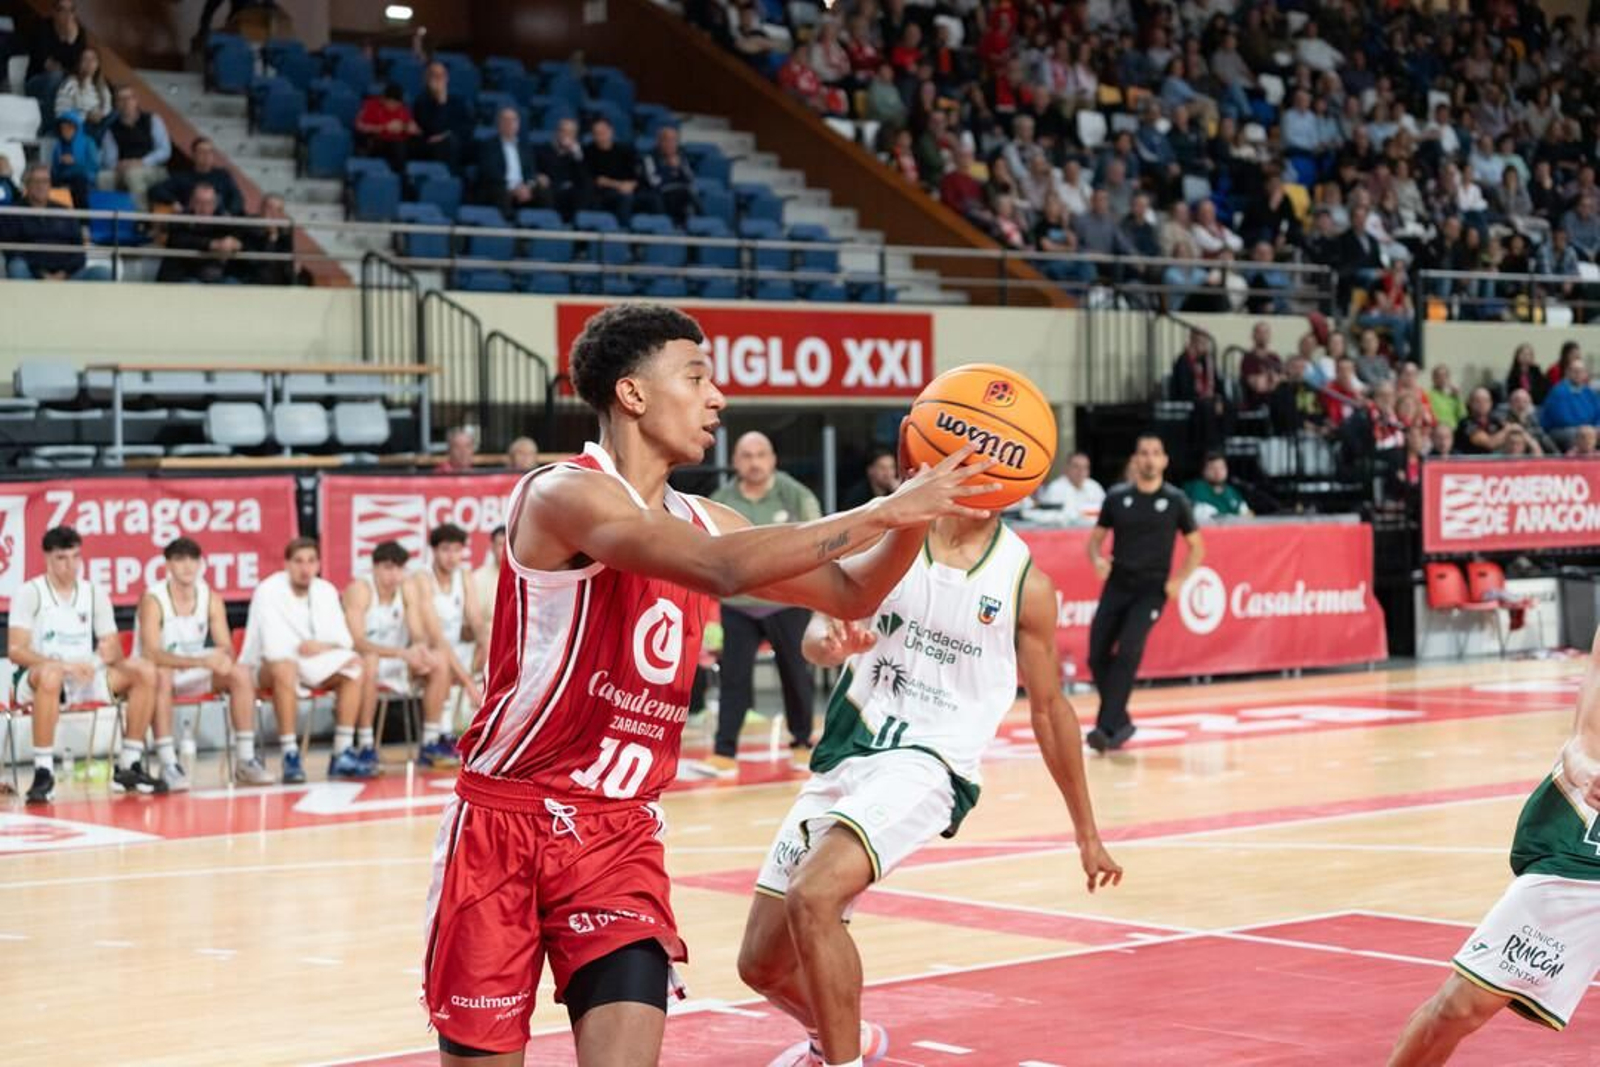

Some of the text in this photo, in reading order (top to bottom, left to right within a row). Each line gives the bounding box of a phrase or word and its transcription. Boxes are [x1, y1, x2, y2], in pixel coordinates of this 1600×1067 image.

[842, 337, 923, 388] XXI
[935, 411, 1027, 471] Wilson
[1484, 474, 1590, 505] GOBIERNO
[46, 490, 261, 547] Zaragoza
[1483, 506, 1509, 535] DE
[75, 551, 259, 595] EPOTE
[904, 635, 957, 665] Uncaja
[908, 620, 983, 658] Fundación
[609, 715, 665, 741] ZARAGOZA
[874, 715, 909, 747] 11
[570, 737, 653, 799] 10
[1499, 960, 1541, 986] DENTAL
